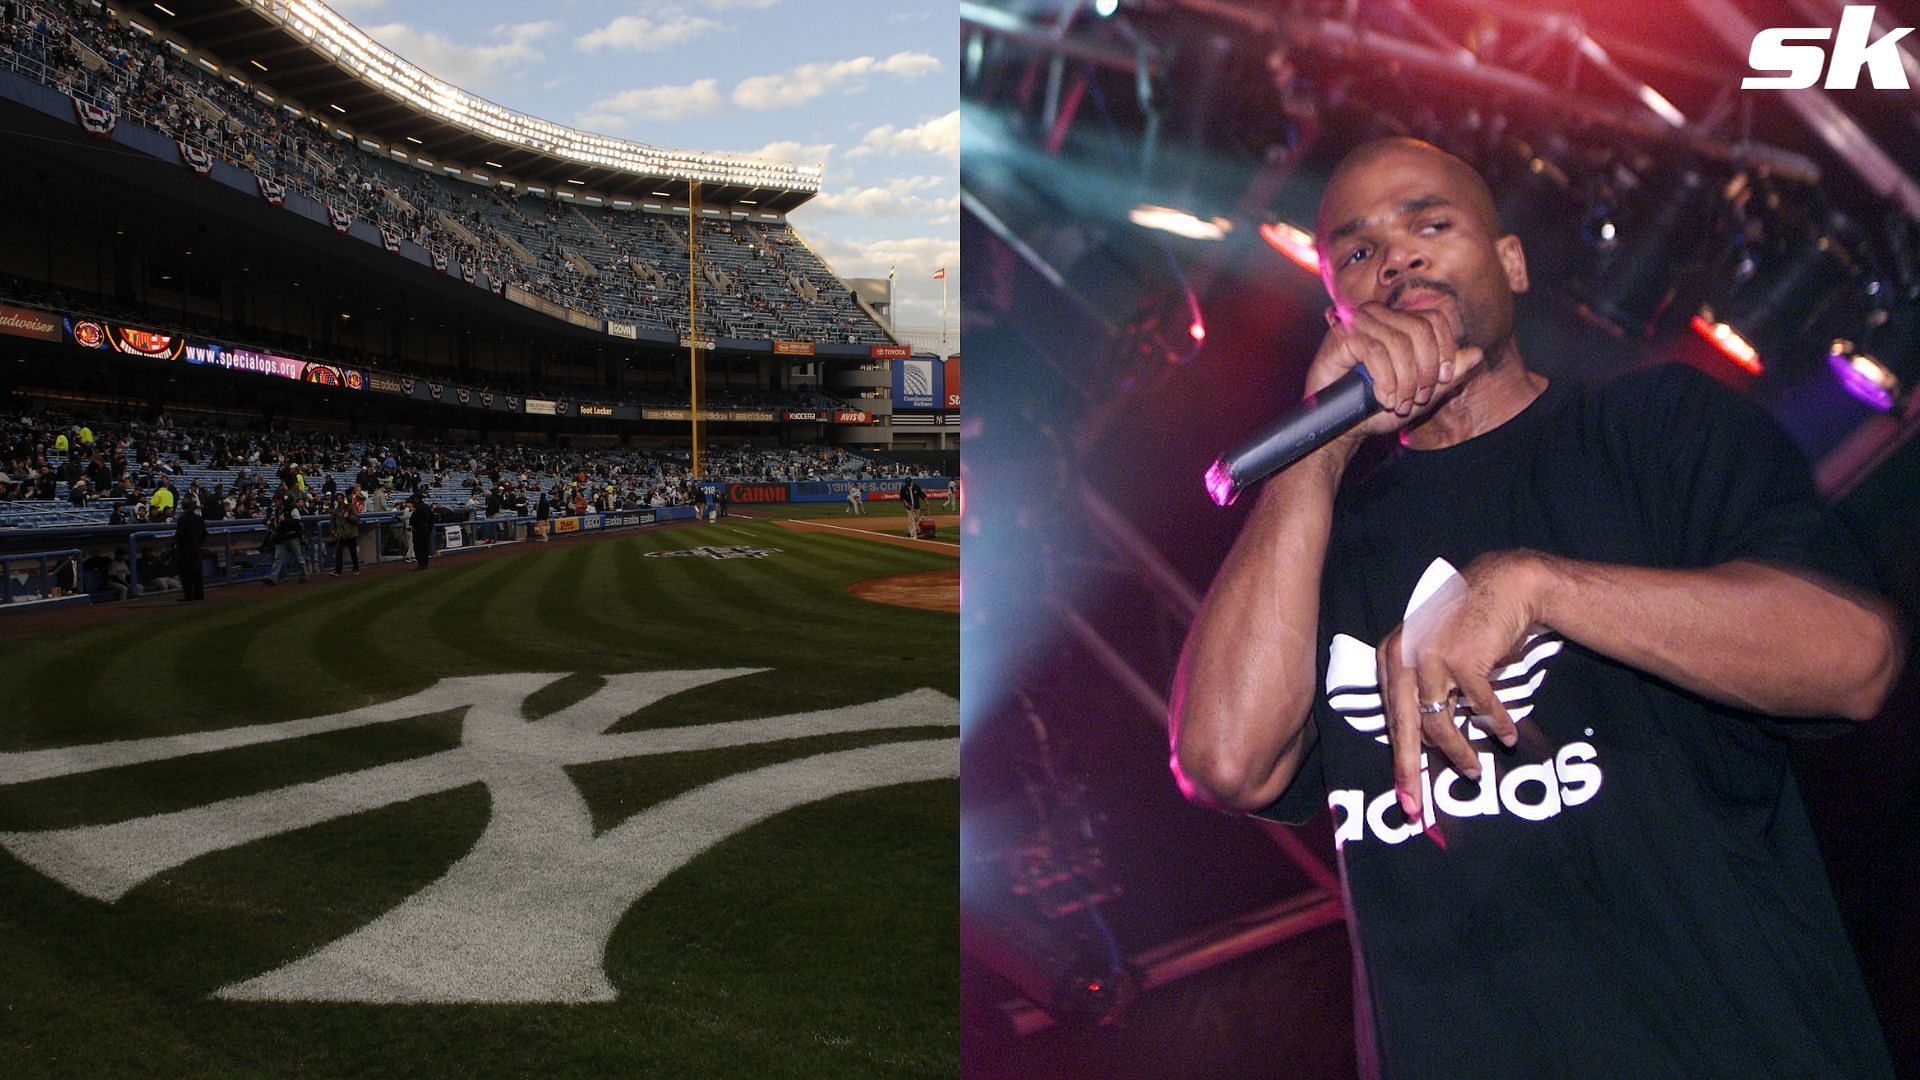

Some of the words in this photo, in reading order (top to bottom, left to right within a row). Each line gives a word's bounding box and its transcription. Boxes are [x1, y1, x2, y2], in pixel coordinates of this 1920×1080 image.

[0, 312, 54, 333] udweiser
[613, 323, 631, 335] GOYA
[185, 345, 296, 379] www.specialops.org
[380, 381, 401, 392] adidas
[580, 406, 593, 415] Foot
[593, 406, 613, 416] Locker
[789, 412, 816, 420] KYOCERA
[840, 412, 857, 422] AVIS
[730, 484, 785, 503] Canon
[1328, 741, 1603, 846] adidas
